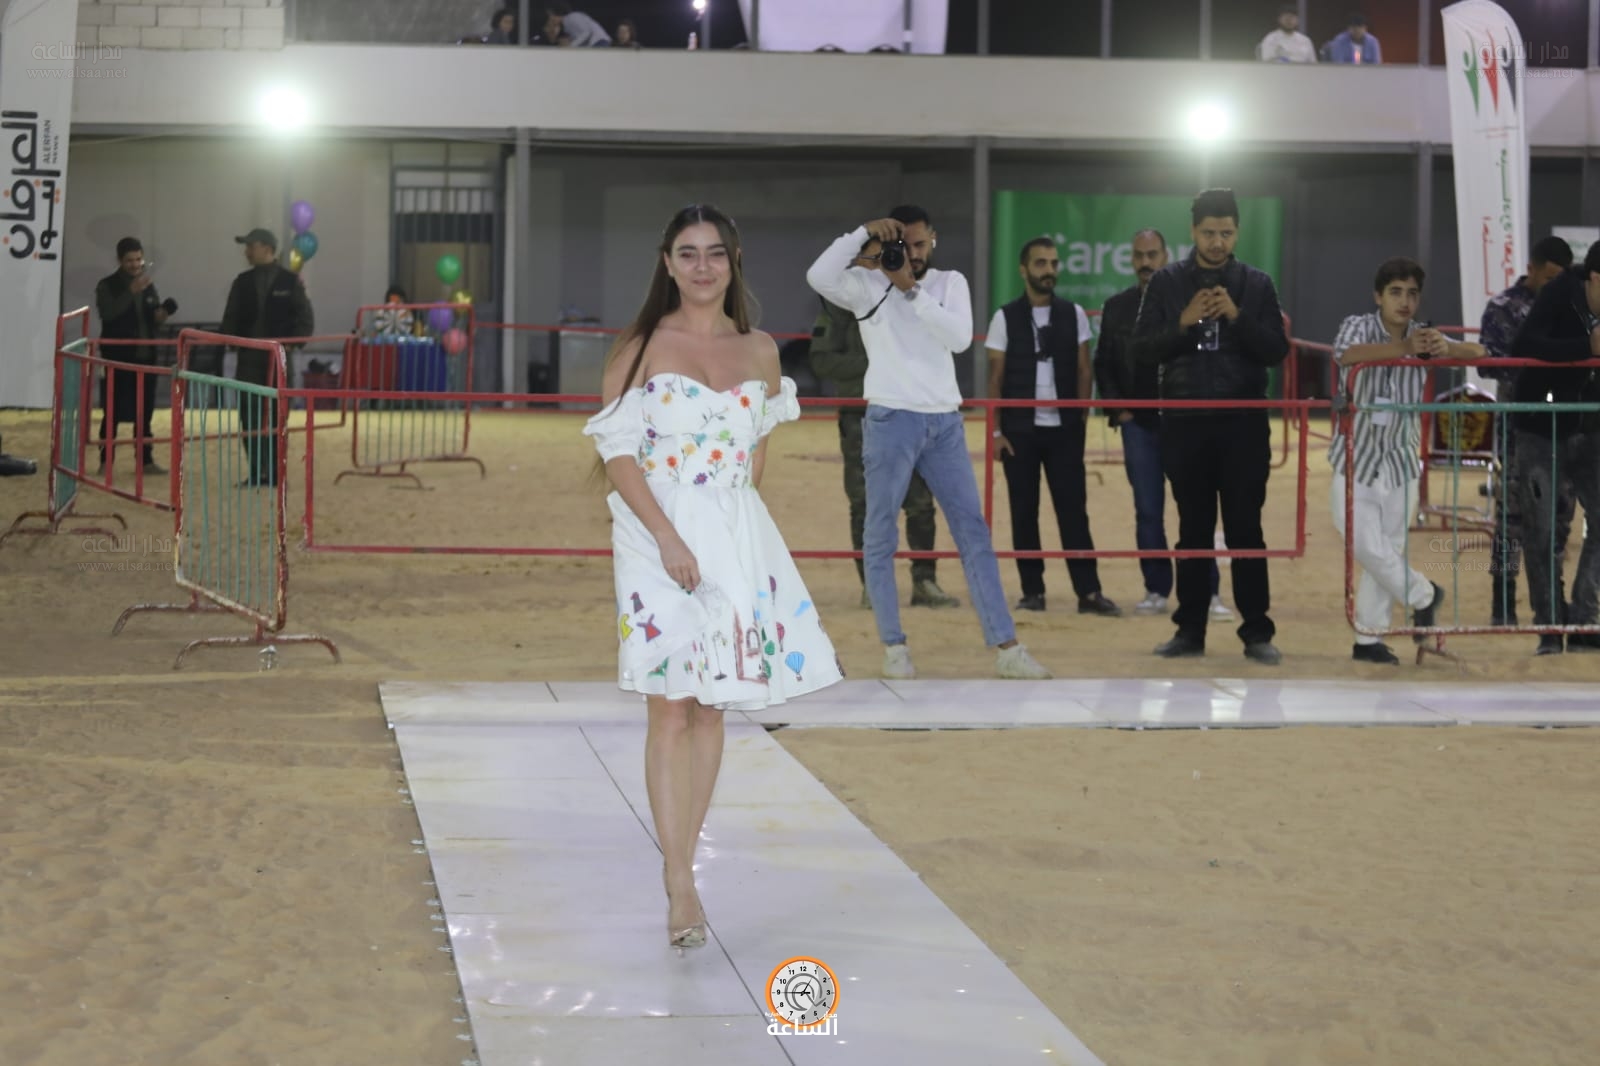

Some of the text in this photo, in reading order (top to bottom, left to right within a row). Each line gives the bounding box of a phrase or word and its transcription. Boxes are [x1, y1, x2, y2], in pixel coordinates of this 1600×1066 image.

[42, 119, 51, 165] ALERFAN
[0, 110, 61, 260] العرفان
[33, 178, 61, 260] نيوز
